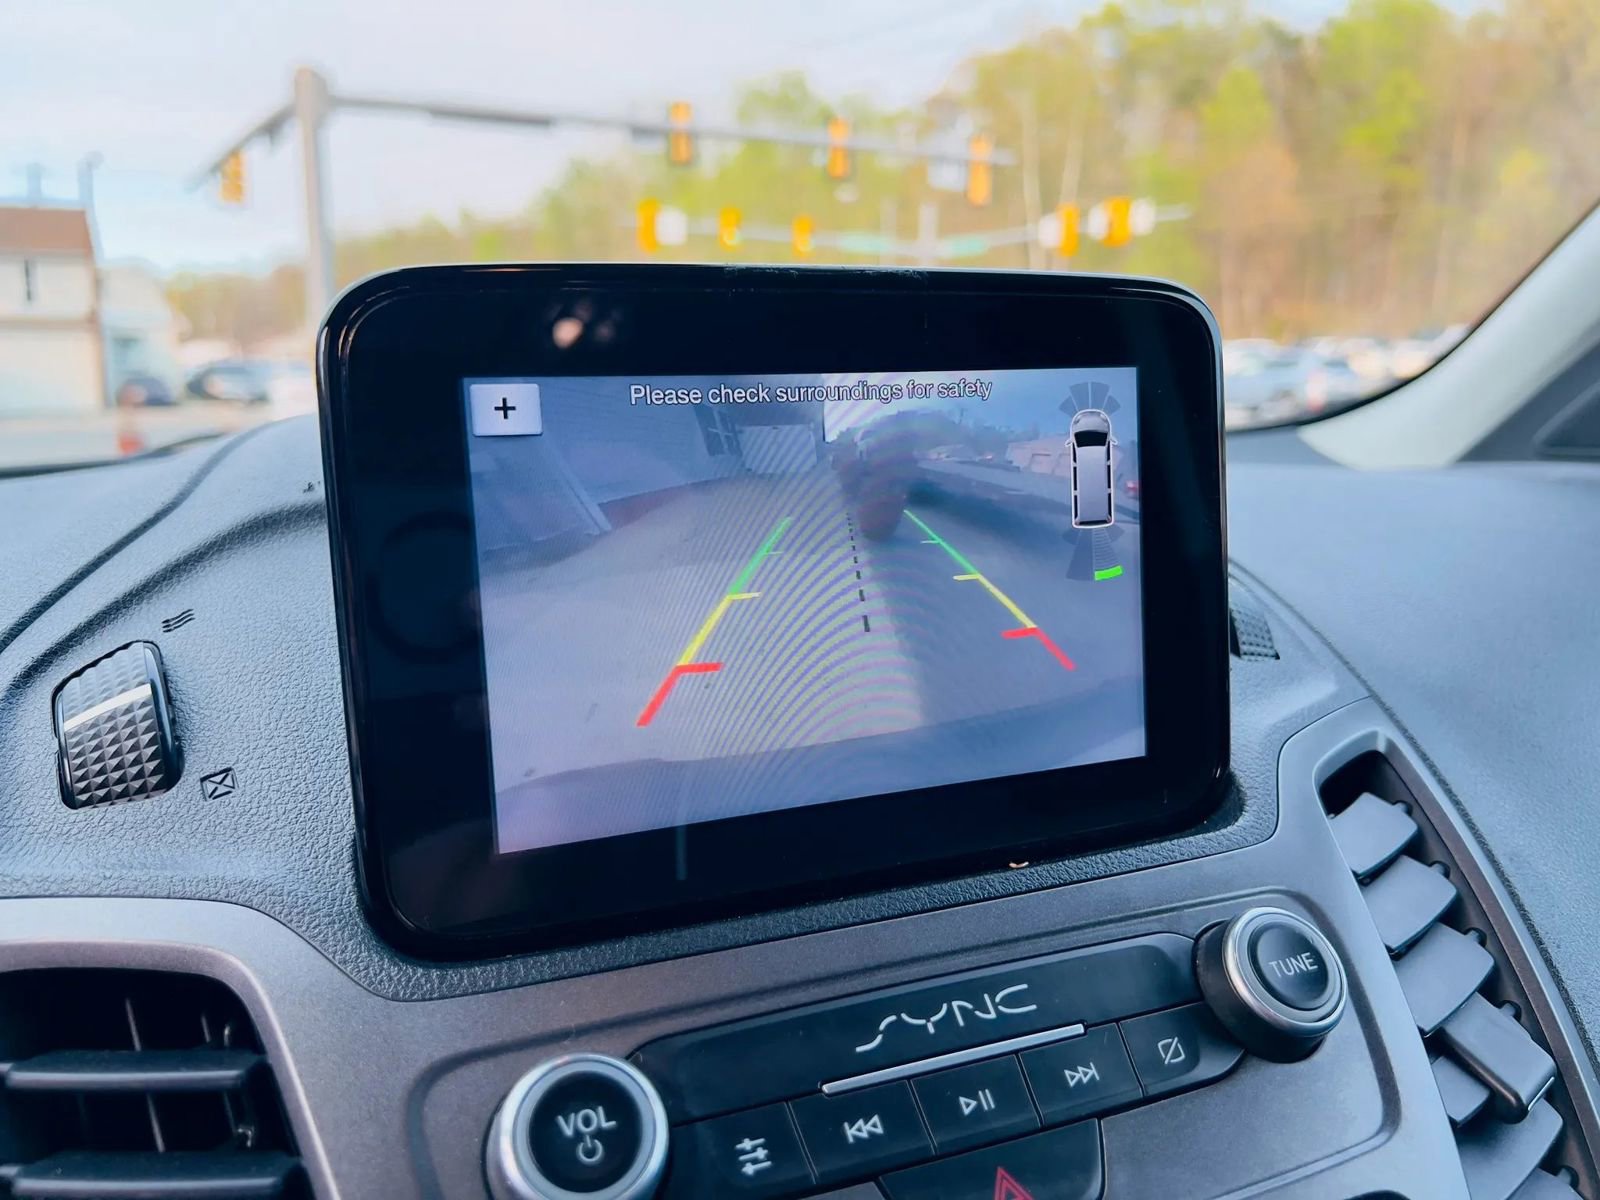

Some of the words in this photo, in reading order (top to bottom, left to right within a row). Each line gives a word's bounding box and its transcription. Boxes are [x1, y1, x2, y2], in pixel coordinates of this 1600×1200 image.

[629, 384, 702, 405] Please
[709, 383, 771, 404] check
[775, 381, 903, 403] surroundings
[906, 380, 934, 399] for
[937, 379, 993, 400] safety
[1267, 952, 1319, 978] TUNE
[855, 983, 1038, 1053] SYNC
[556, 1105, 617, 1137] VOL
